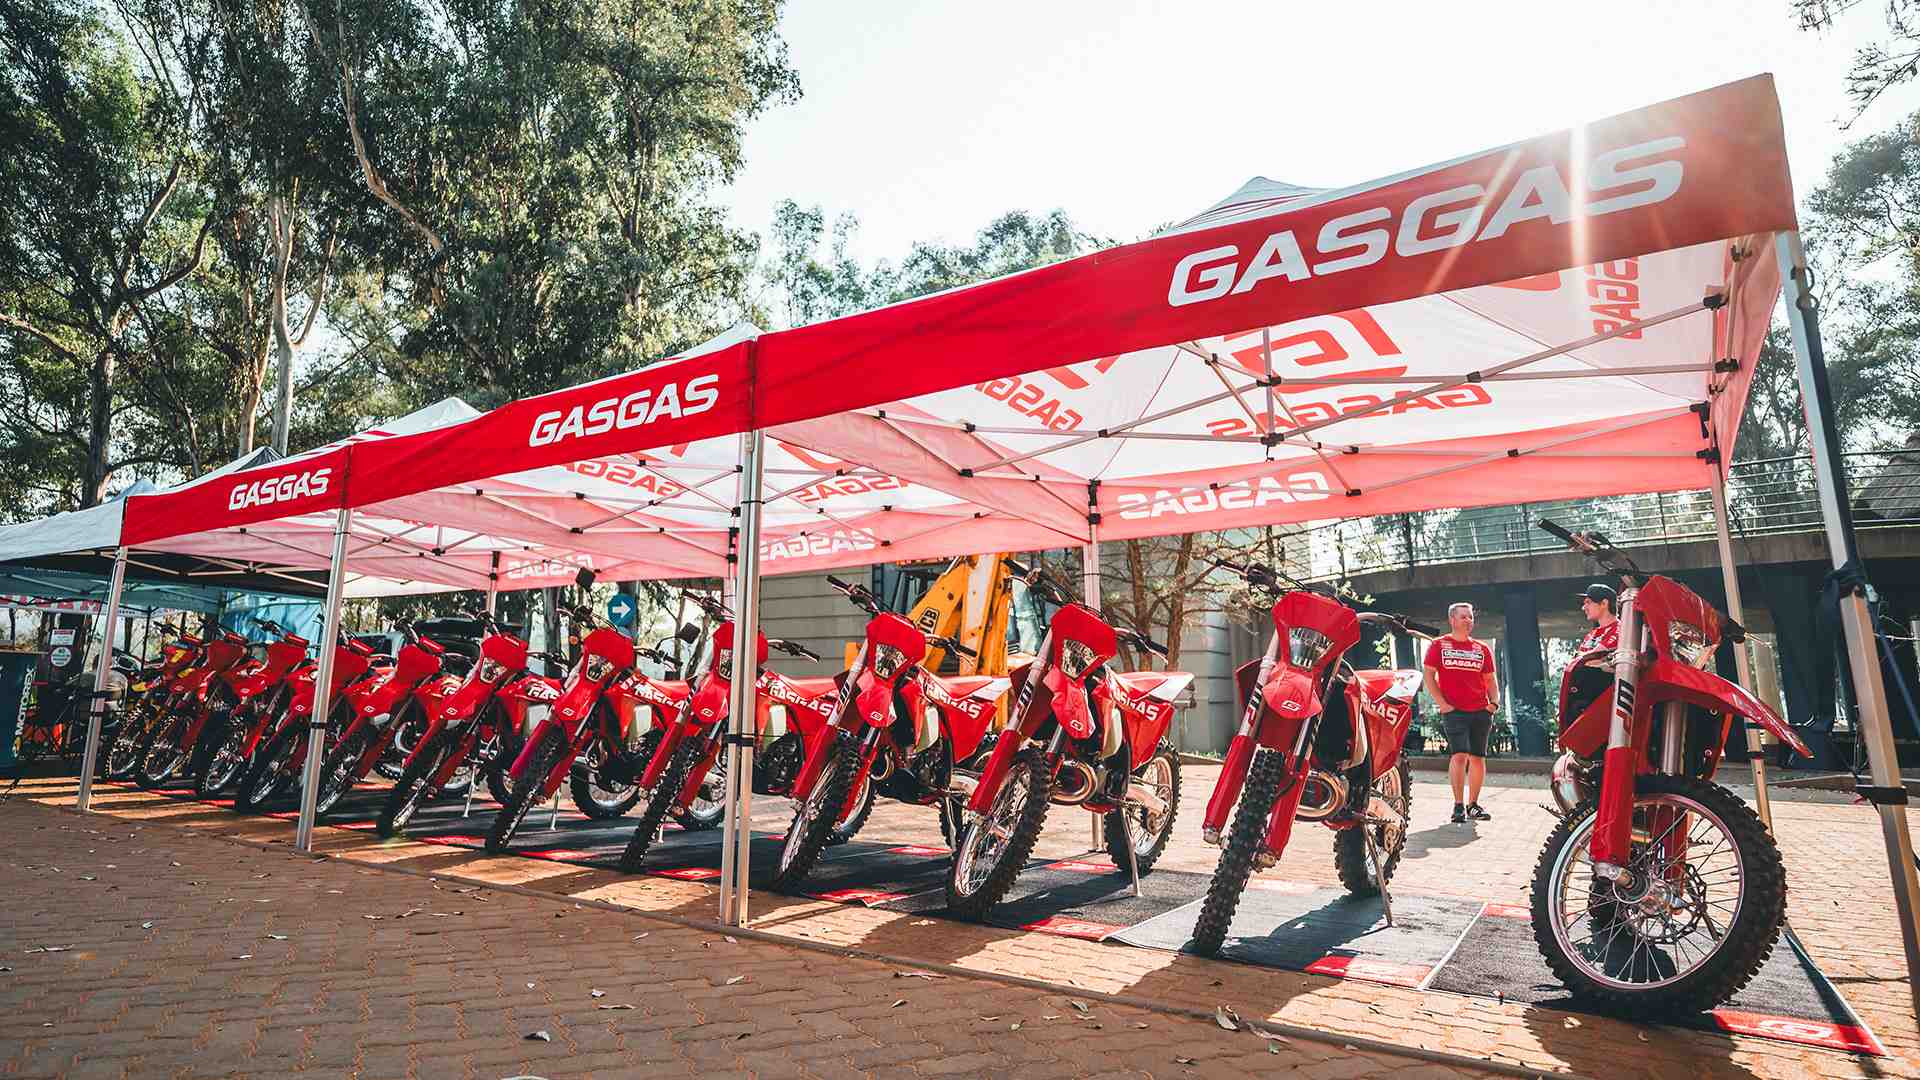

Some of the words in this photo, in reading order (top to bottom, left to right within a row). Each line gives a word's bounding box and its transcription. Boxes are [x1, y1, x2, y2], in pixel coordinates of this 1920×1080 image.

[1168, 136, 1686, 307] GASGAS
[529, 374, 719, 447] GASGAS
[229, 468, 332, 511] GASGAS
[1444, 659, 1481, 668] GASGAS
[15, 666, 37, 735] MOTOREX
